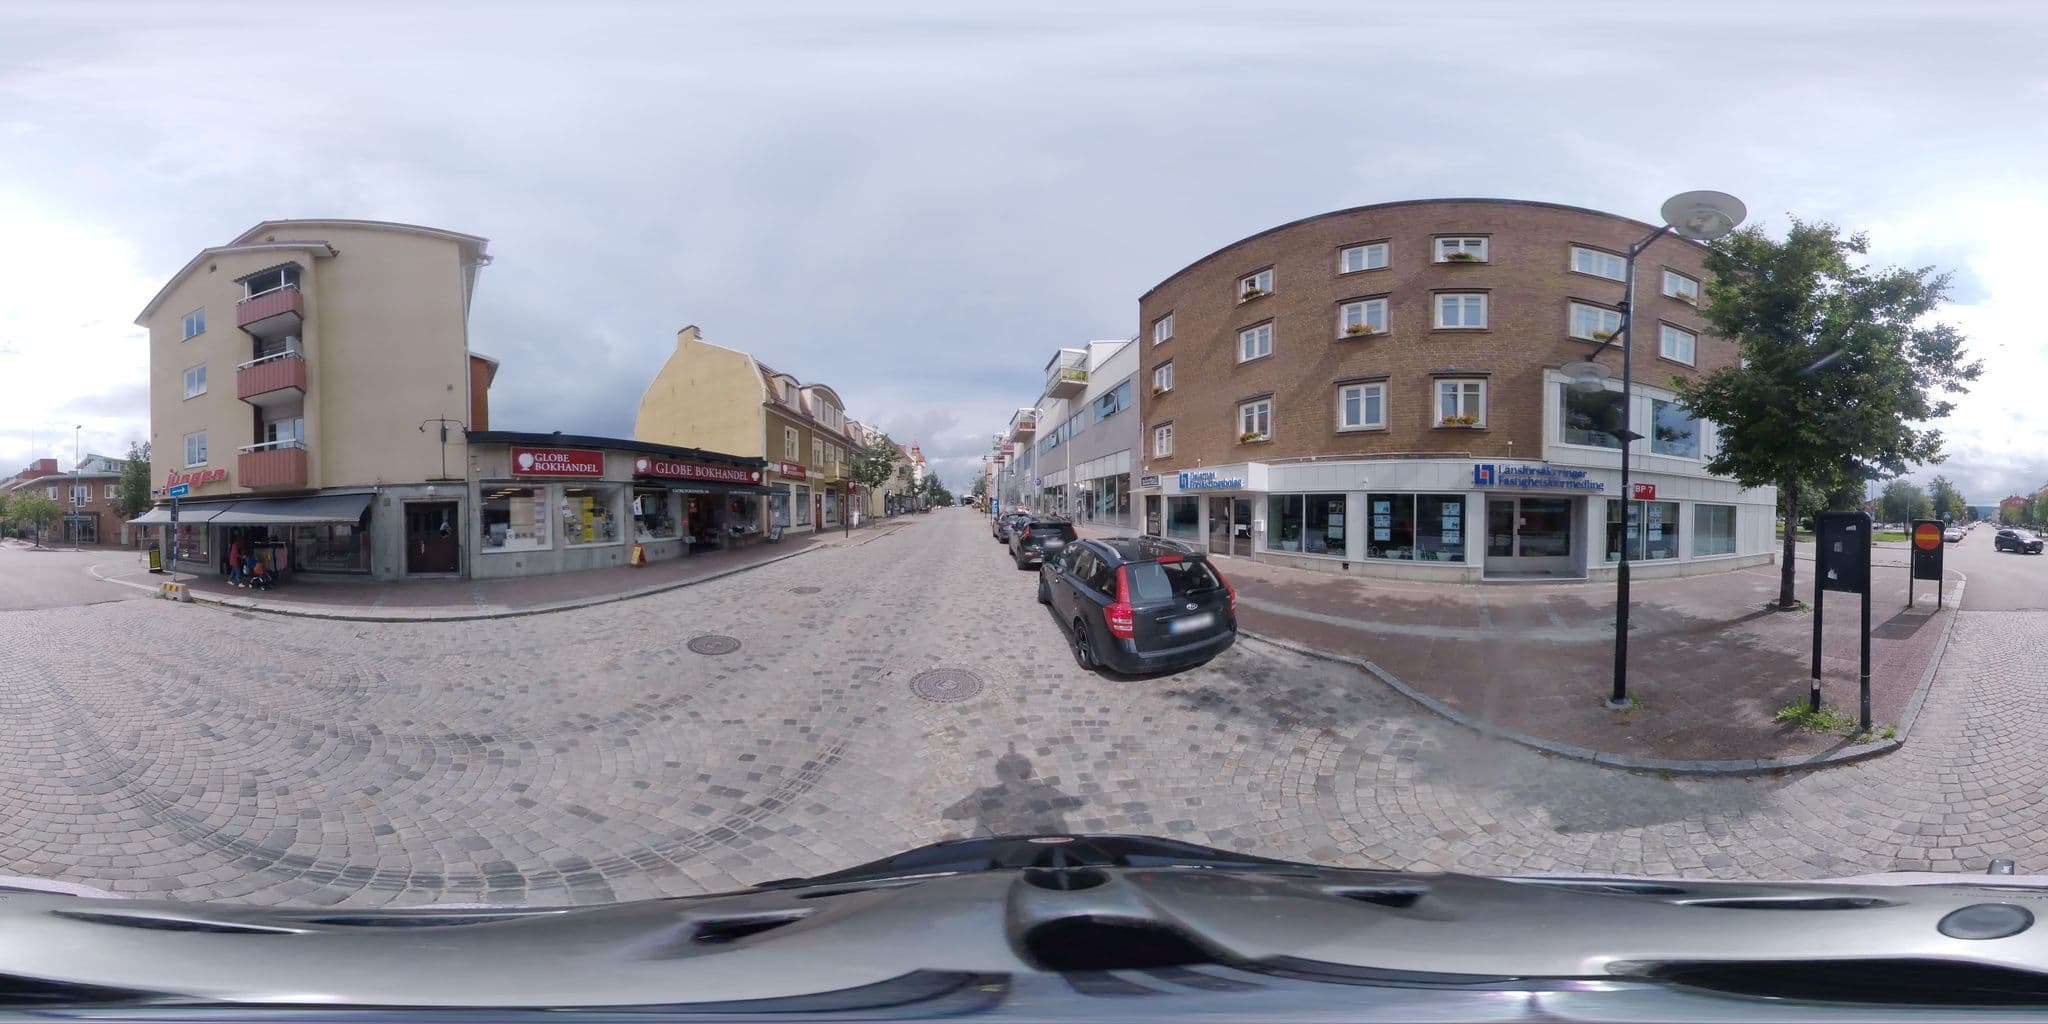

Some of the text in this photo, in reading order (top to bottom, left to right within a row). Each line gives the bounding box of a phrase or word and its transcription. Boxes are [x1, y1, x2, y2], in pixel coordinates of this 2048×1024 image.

[534, 453, 570, 462] GLOBE
[534, 463, 599, 473] BOKHANDEL
[655, 462, 749, 481] GLOBE BOKHANDEL
[1635, 485, 1654, 494] BP 7
